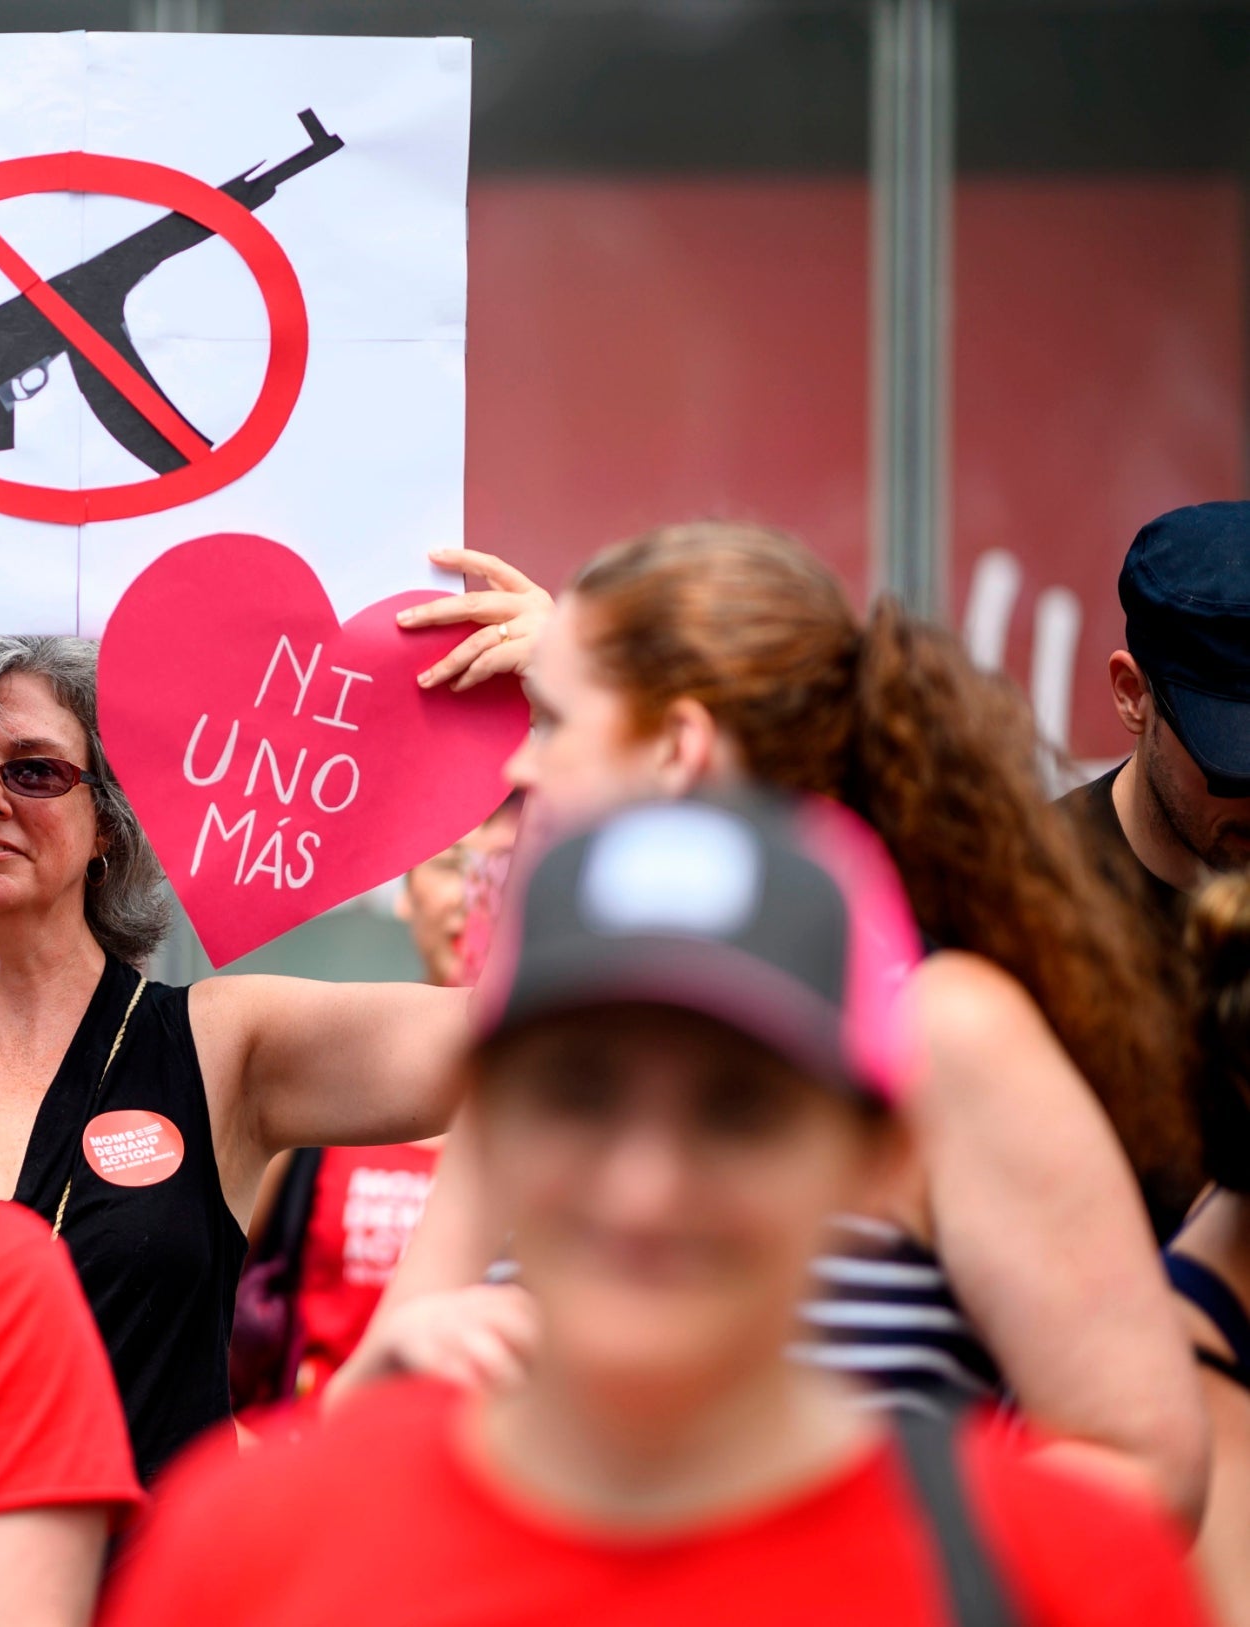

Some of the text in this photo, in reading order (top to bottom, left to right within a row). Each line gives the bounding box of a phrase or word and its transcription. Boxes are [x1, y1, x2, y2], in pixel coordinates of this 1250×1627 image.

[254, 634, 373, 731] NI
[182, 713, 360, 813] UNO
[190, 802, 321, 890] MÁS
[89, 1130, 136, 1147] MOMS
[93, 1135, 159, 1158] DEMAND
[100, 1146, 156, 1168] ACTION
